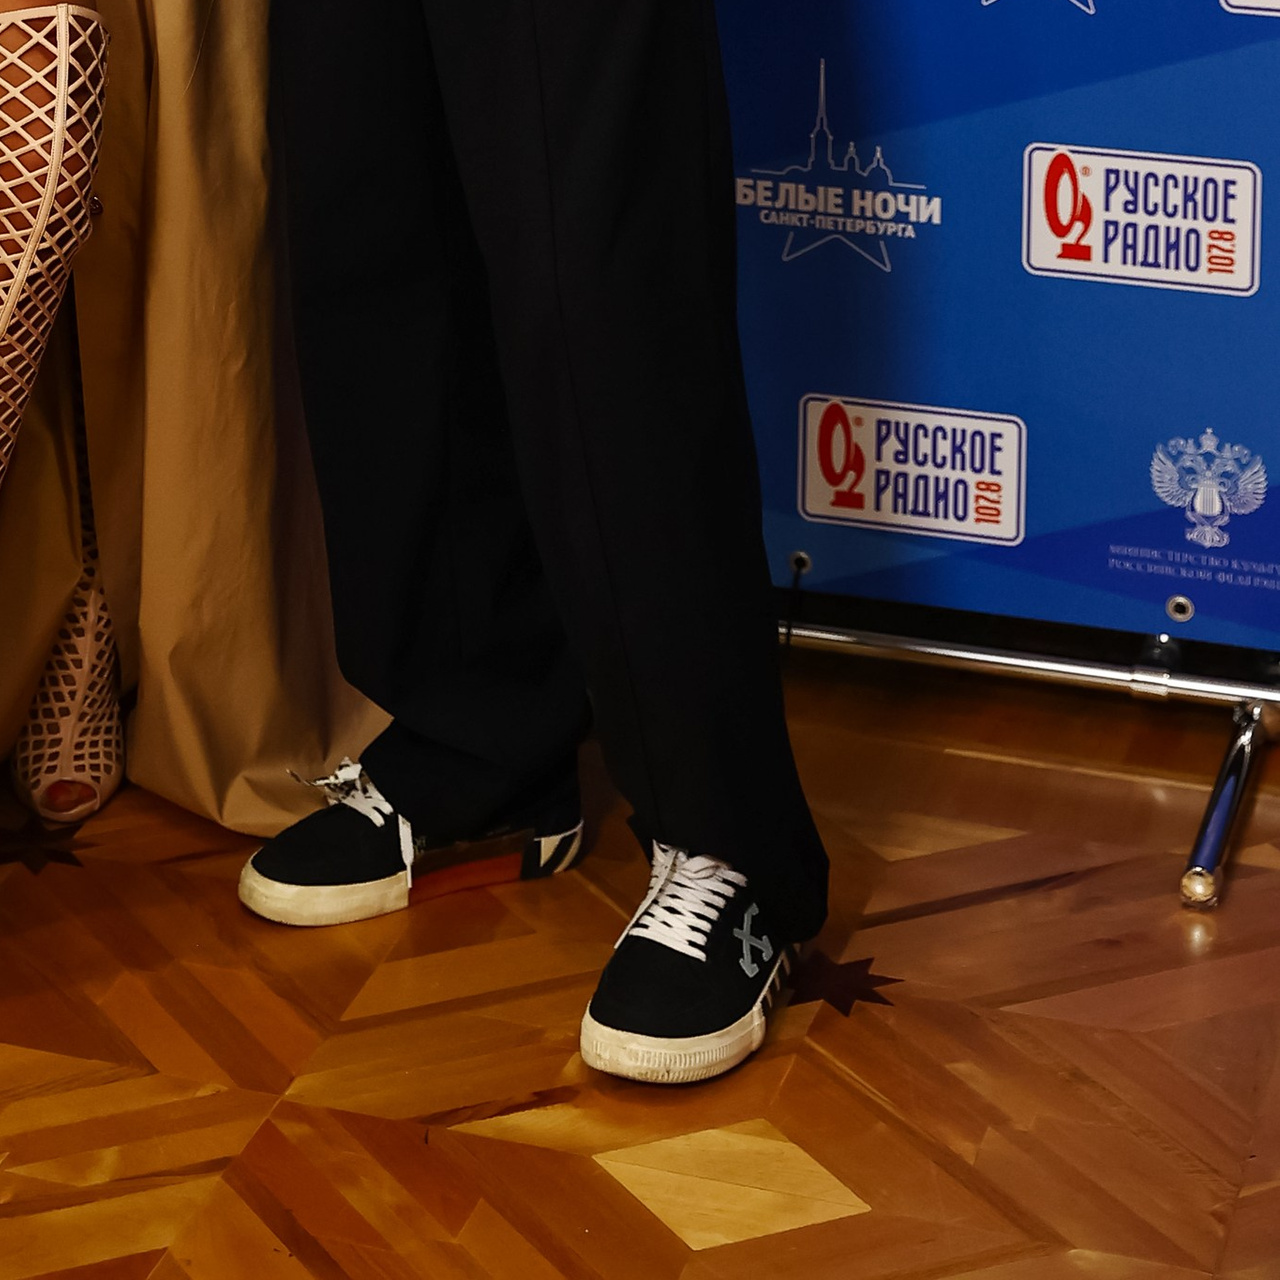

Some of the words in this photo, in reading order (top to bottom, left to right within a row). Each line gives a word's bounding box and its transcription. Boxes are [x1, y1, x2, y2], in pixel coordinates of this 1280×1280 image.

[1103, 168, 1238, 225] РУССКОЕ
[1102, 220, 1202, 275] РАДИО
[874, 418, 1003, 476] РУССКОЕ
[874, 468, 969, 524] РАДИО
